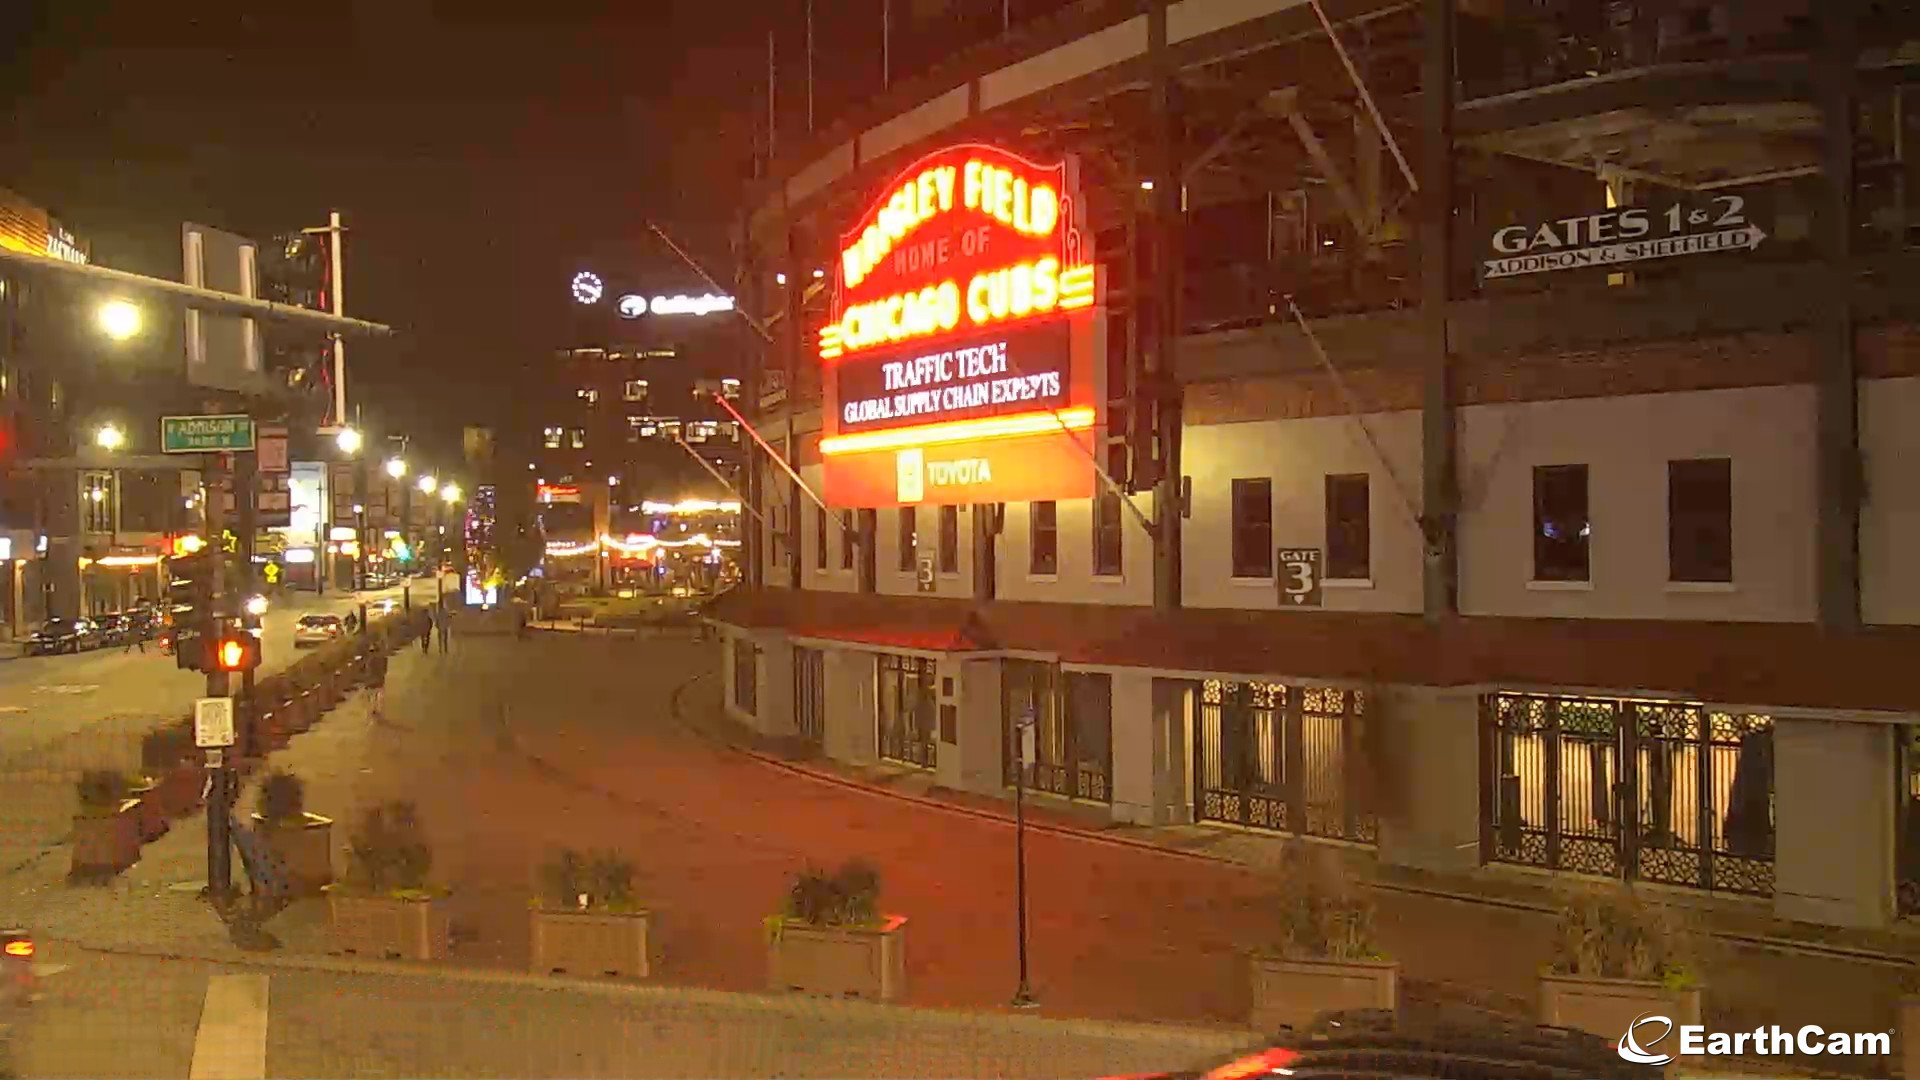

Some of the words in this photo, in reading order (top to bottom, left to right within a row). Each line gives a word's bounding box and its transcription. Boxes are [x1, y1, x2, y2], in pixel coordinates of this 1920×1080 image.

[964, 159, 1058, 235] FIELD
[893, 237, 950, 275] HOME
[961, 225, 991, 256] OF
[1492, 208, 1650, 254] GATES
[1493, 250, 1591, 275] ADDISON
[1600, 247, 1617, 262] &
[1625, 231, 1749, 258] SHEFFIELD
[842, 280, 960, 349] CHICAGO
[966, 256, 1060, 325] CUBS
[882, 352, 953, 391] TRAFFIC
[956, 342, 1007, 379] TECH
[844, 396, 893, 424] GLOBAL
[894, 388, 942, 417] SUPPLY
[943, 380, 988, 410] CHAIN
[926, 457, 992, 487] TOYOTA
[919, 559, 933, 583] 3
[1280, 550, 1320, 562] GATE
[1285, 562, 1313, 594] 3
